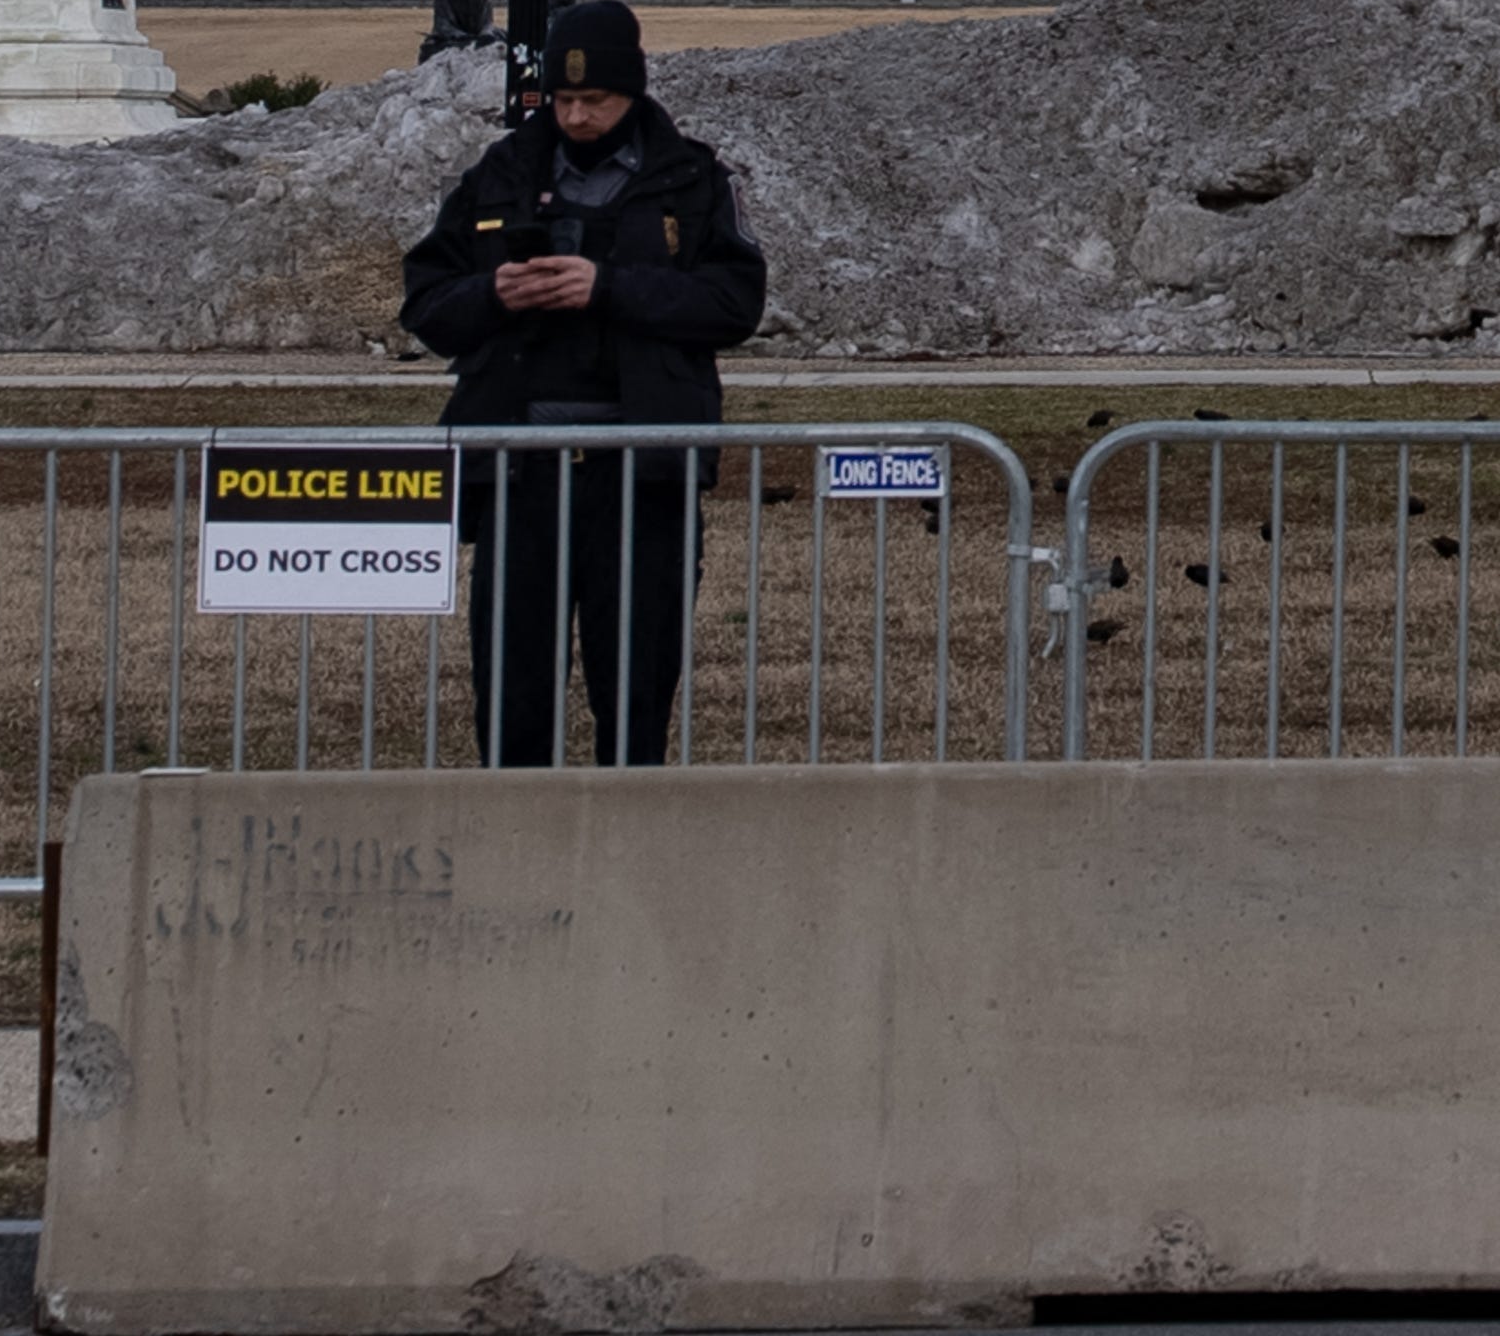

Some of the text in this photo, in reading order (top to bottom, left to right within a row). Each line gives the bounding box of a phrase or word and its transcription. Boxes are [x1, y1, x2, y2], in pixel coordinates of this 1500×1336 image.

[217, 470, 443, 499] POLICE LINE
[830, 455, 937, 486] LONG FENCE
[214, 549, 442, 574] DO NOT CROSS
